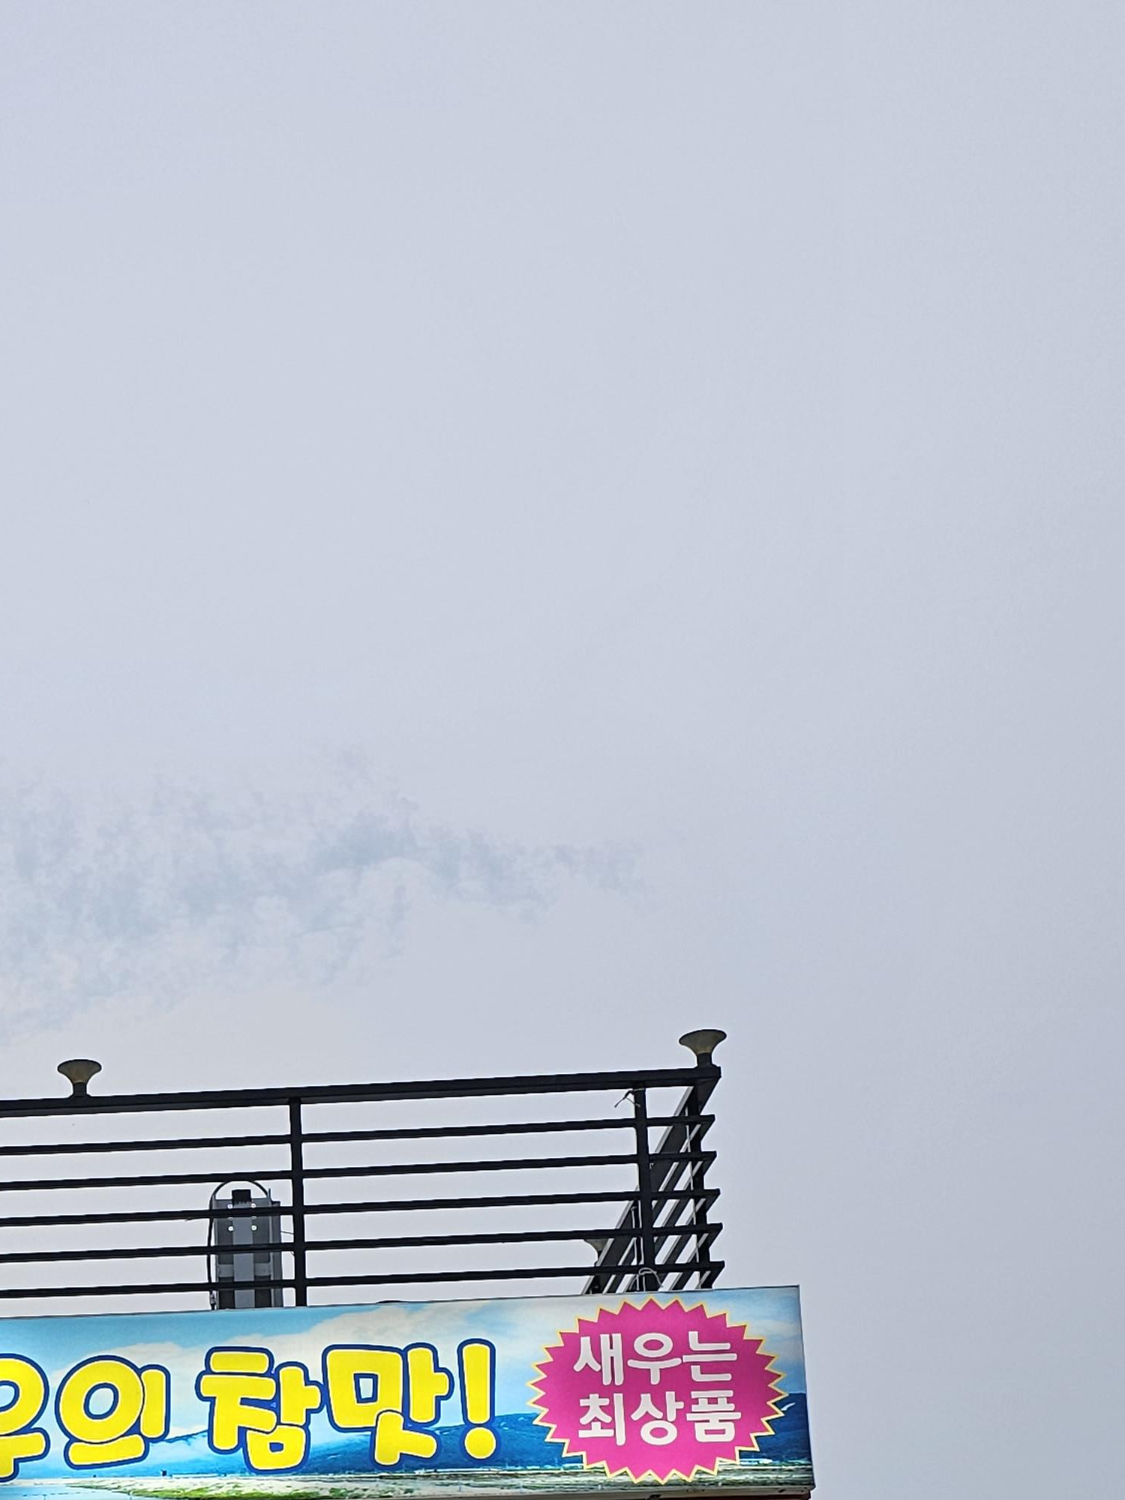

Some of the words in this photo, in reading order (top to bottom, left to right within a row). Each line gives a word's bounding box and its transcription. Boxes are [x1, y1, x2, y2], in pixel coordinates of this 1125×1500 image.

[574, 1330, 738, 1386] 새우는
[196, 1338, 501, 1473] 참맛!
[577, 1393, 742, 1447] 최상품
